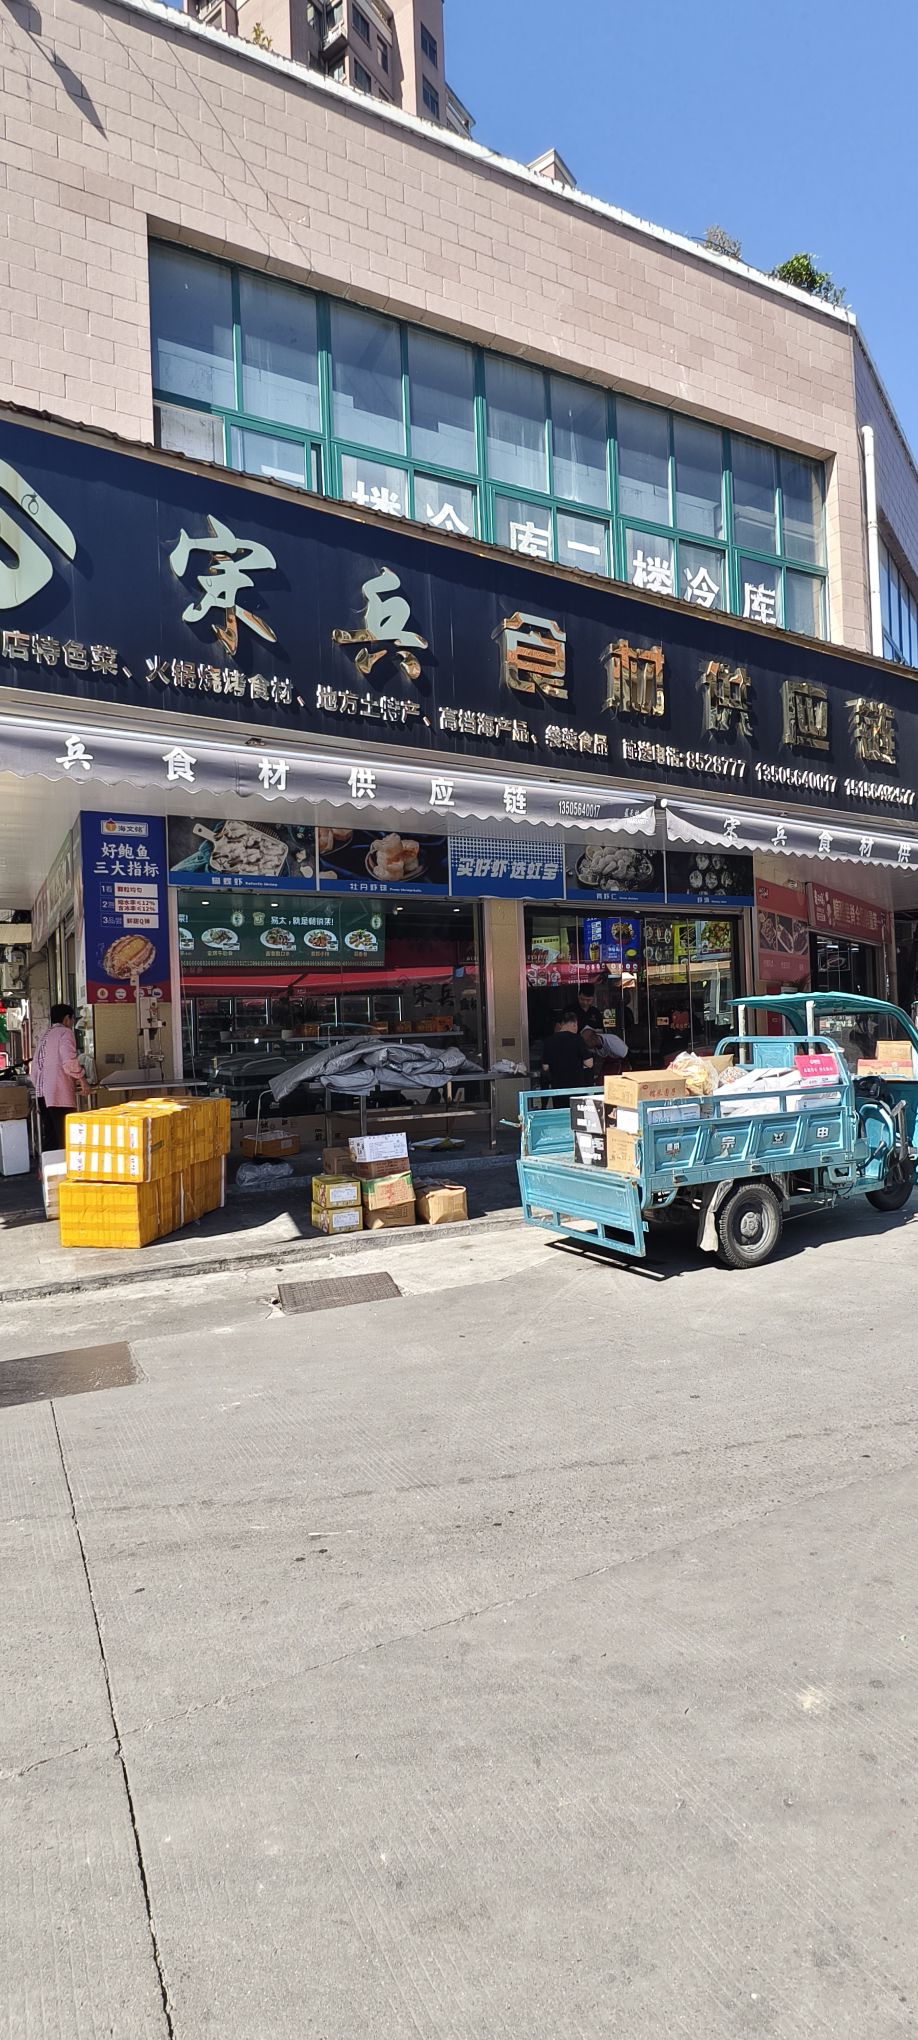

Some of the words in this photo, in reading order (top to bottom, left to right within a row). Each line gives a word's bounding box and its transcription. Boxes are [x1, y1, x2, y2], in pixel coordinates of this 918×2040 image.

[169, 514, 897, 764] 宋兵食材供应链
[754, 762, 837, 793] 13505640017
[558, 801, 601, 818] 13505640017
[101, 842, 150, 860] 好鲍鱼
[94, 861, 160, 877] 三大指标
